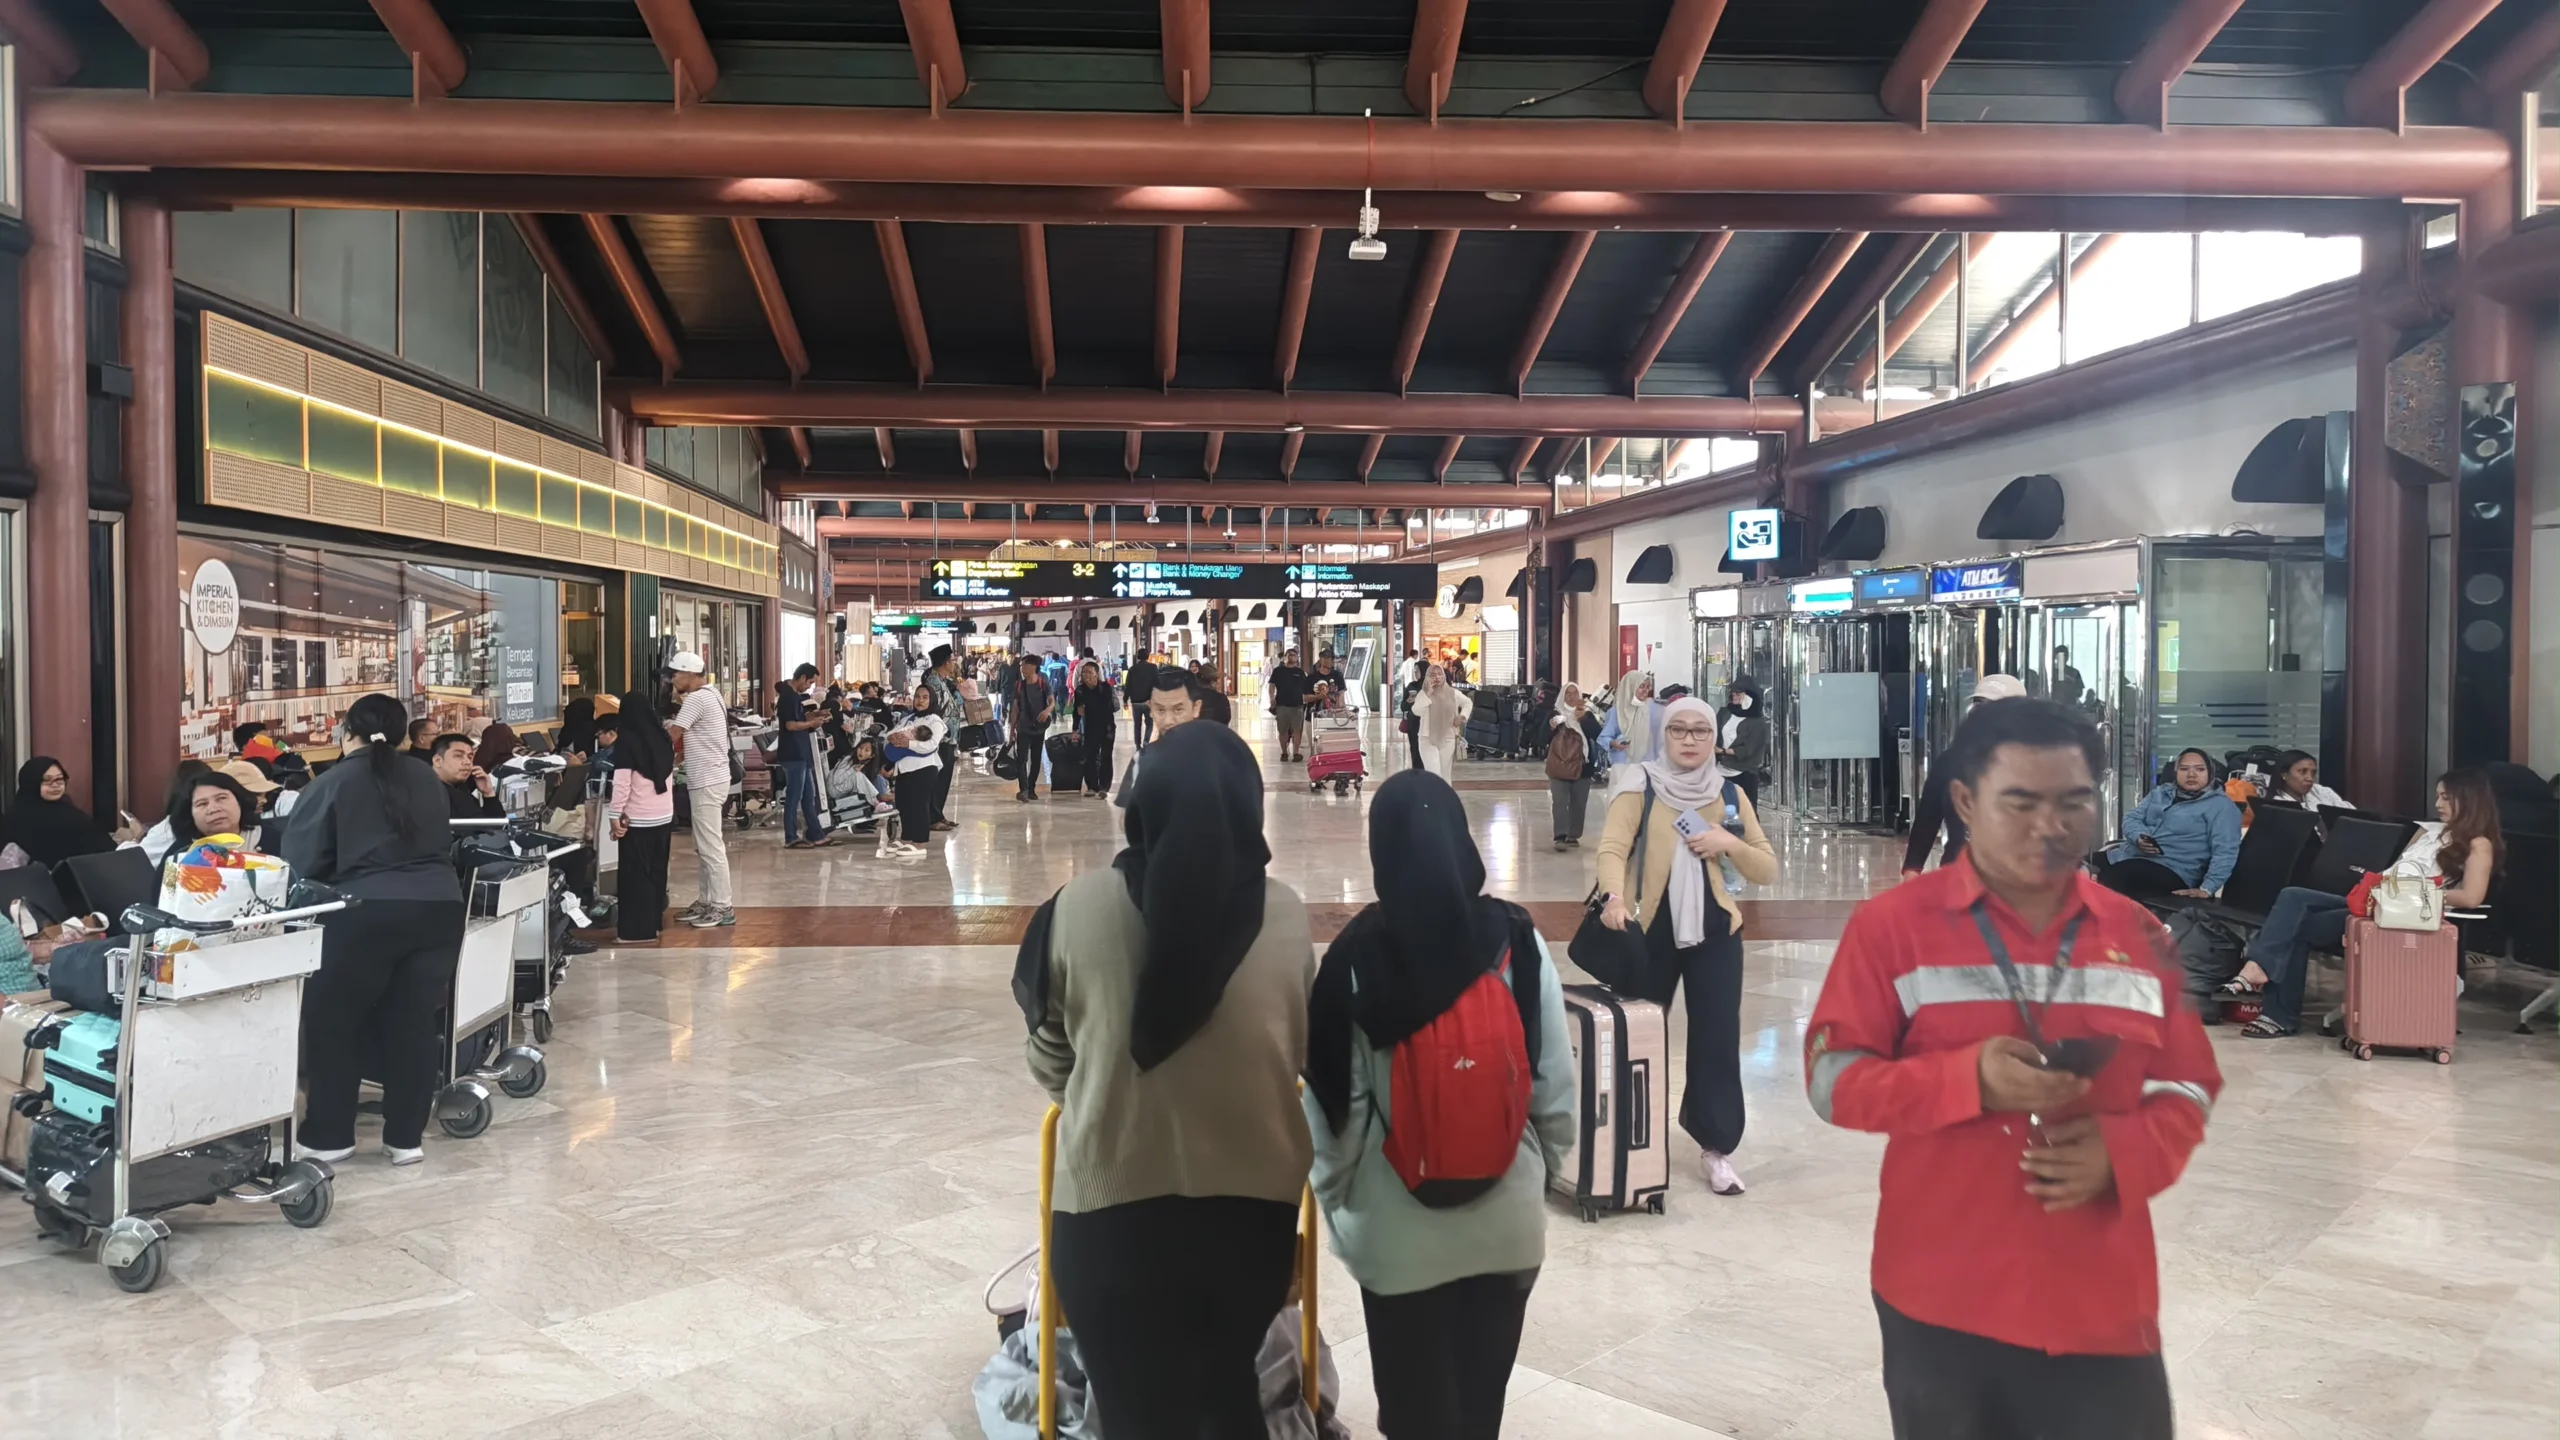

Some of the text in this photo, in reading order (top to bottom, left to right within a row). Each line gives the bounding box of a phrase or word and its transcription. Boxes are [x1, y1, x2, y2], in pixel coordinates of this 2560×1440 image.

[1072, 562, 1095, 577] 3-2
[1189, 564, 1224, 572] Penukaran
[1225, 564, 1243, 573] Uang
[1189, 571, 1211, 579] Money
[1212, 571, 1241, 579] Changer
[968, 580, 985, 588] ATM
[1961, 568, 1999, 587] ATM BCA
[197, 584, 233, 599] IMPERIAL
[968, 588, 1010, 596] ATM Center
[1146, 589, 1169, 597] Prayer
[1359, 583, 1391, 591] Maskapai
[196, 599, 234, 614] KITCHEN
[204, 615, 234, 628] DIMSUM
[506, 646, 534, 665] Tempat
[506, 666, 534, 679] Bersantap
[508, 685, 533, 701] Pilihan
[506, 706, 534, 721] Keluarga
